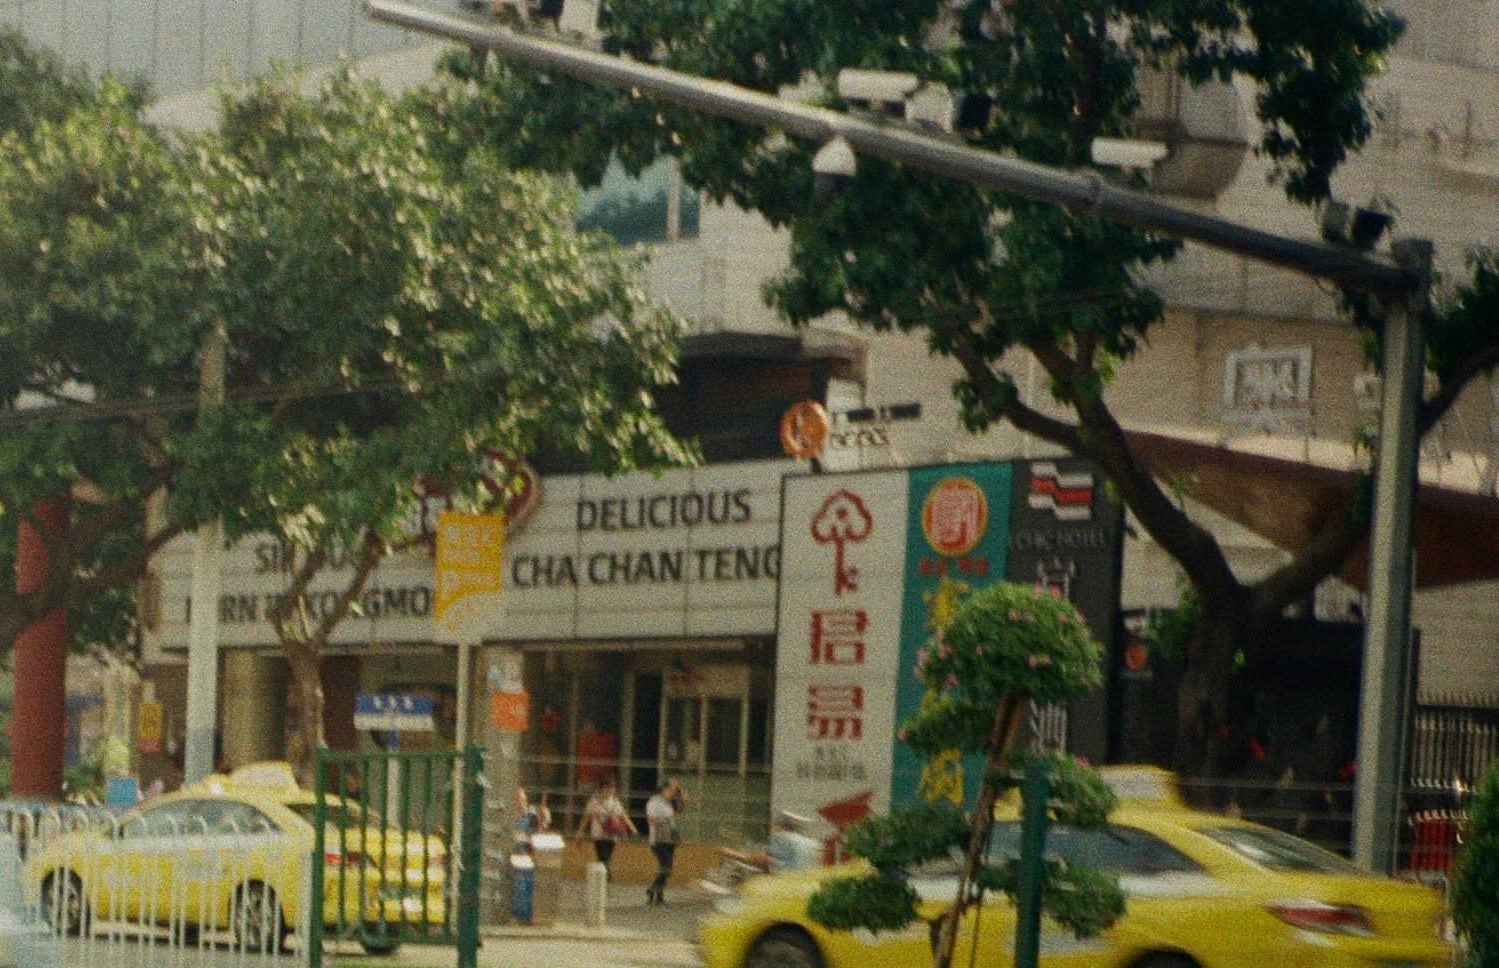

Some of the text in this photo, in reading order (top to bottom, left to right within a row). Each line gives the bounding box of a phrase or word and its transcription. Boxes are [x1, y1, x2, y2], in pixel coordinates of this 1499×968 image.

[577, 487, 752, 531] DELICIOUS
[512, 553, 578, 587] CHA
[588, 550, 683, 584] CHAN
